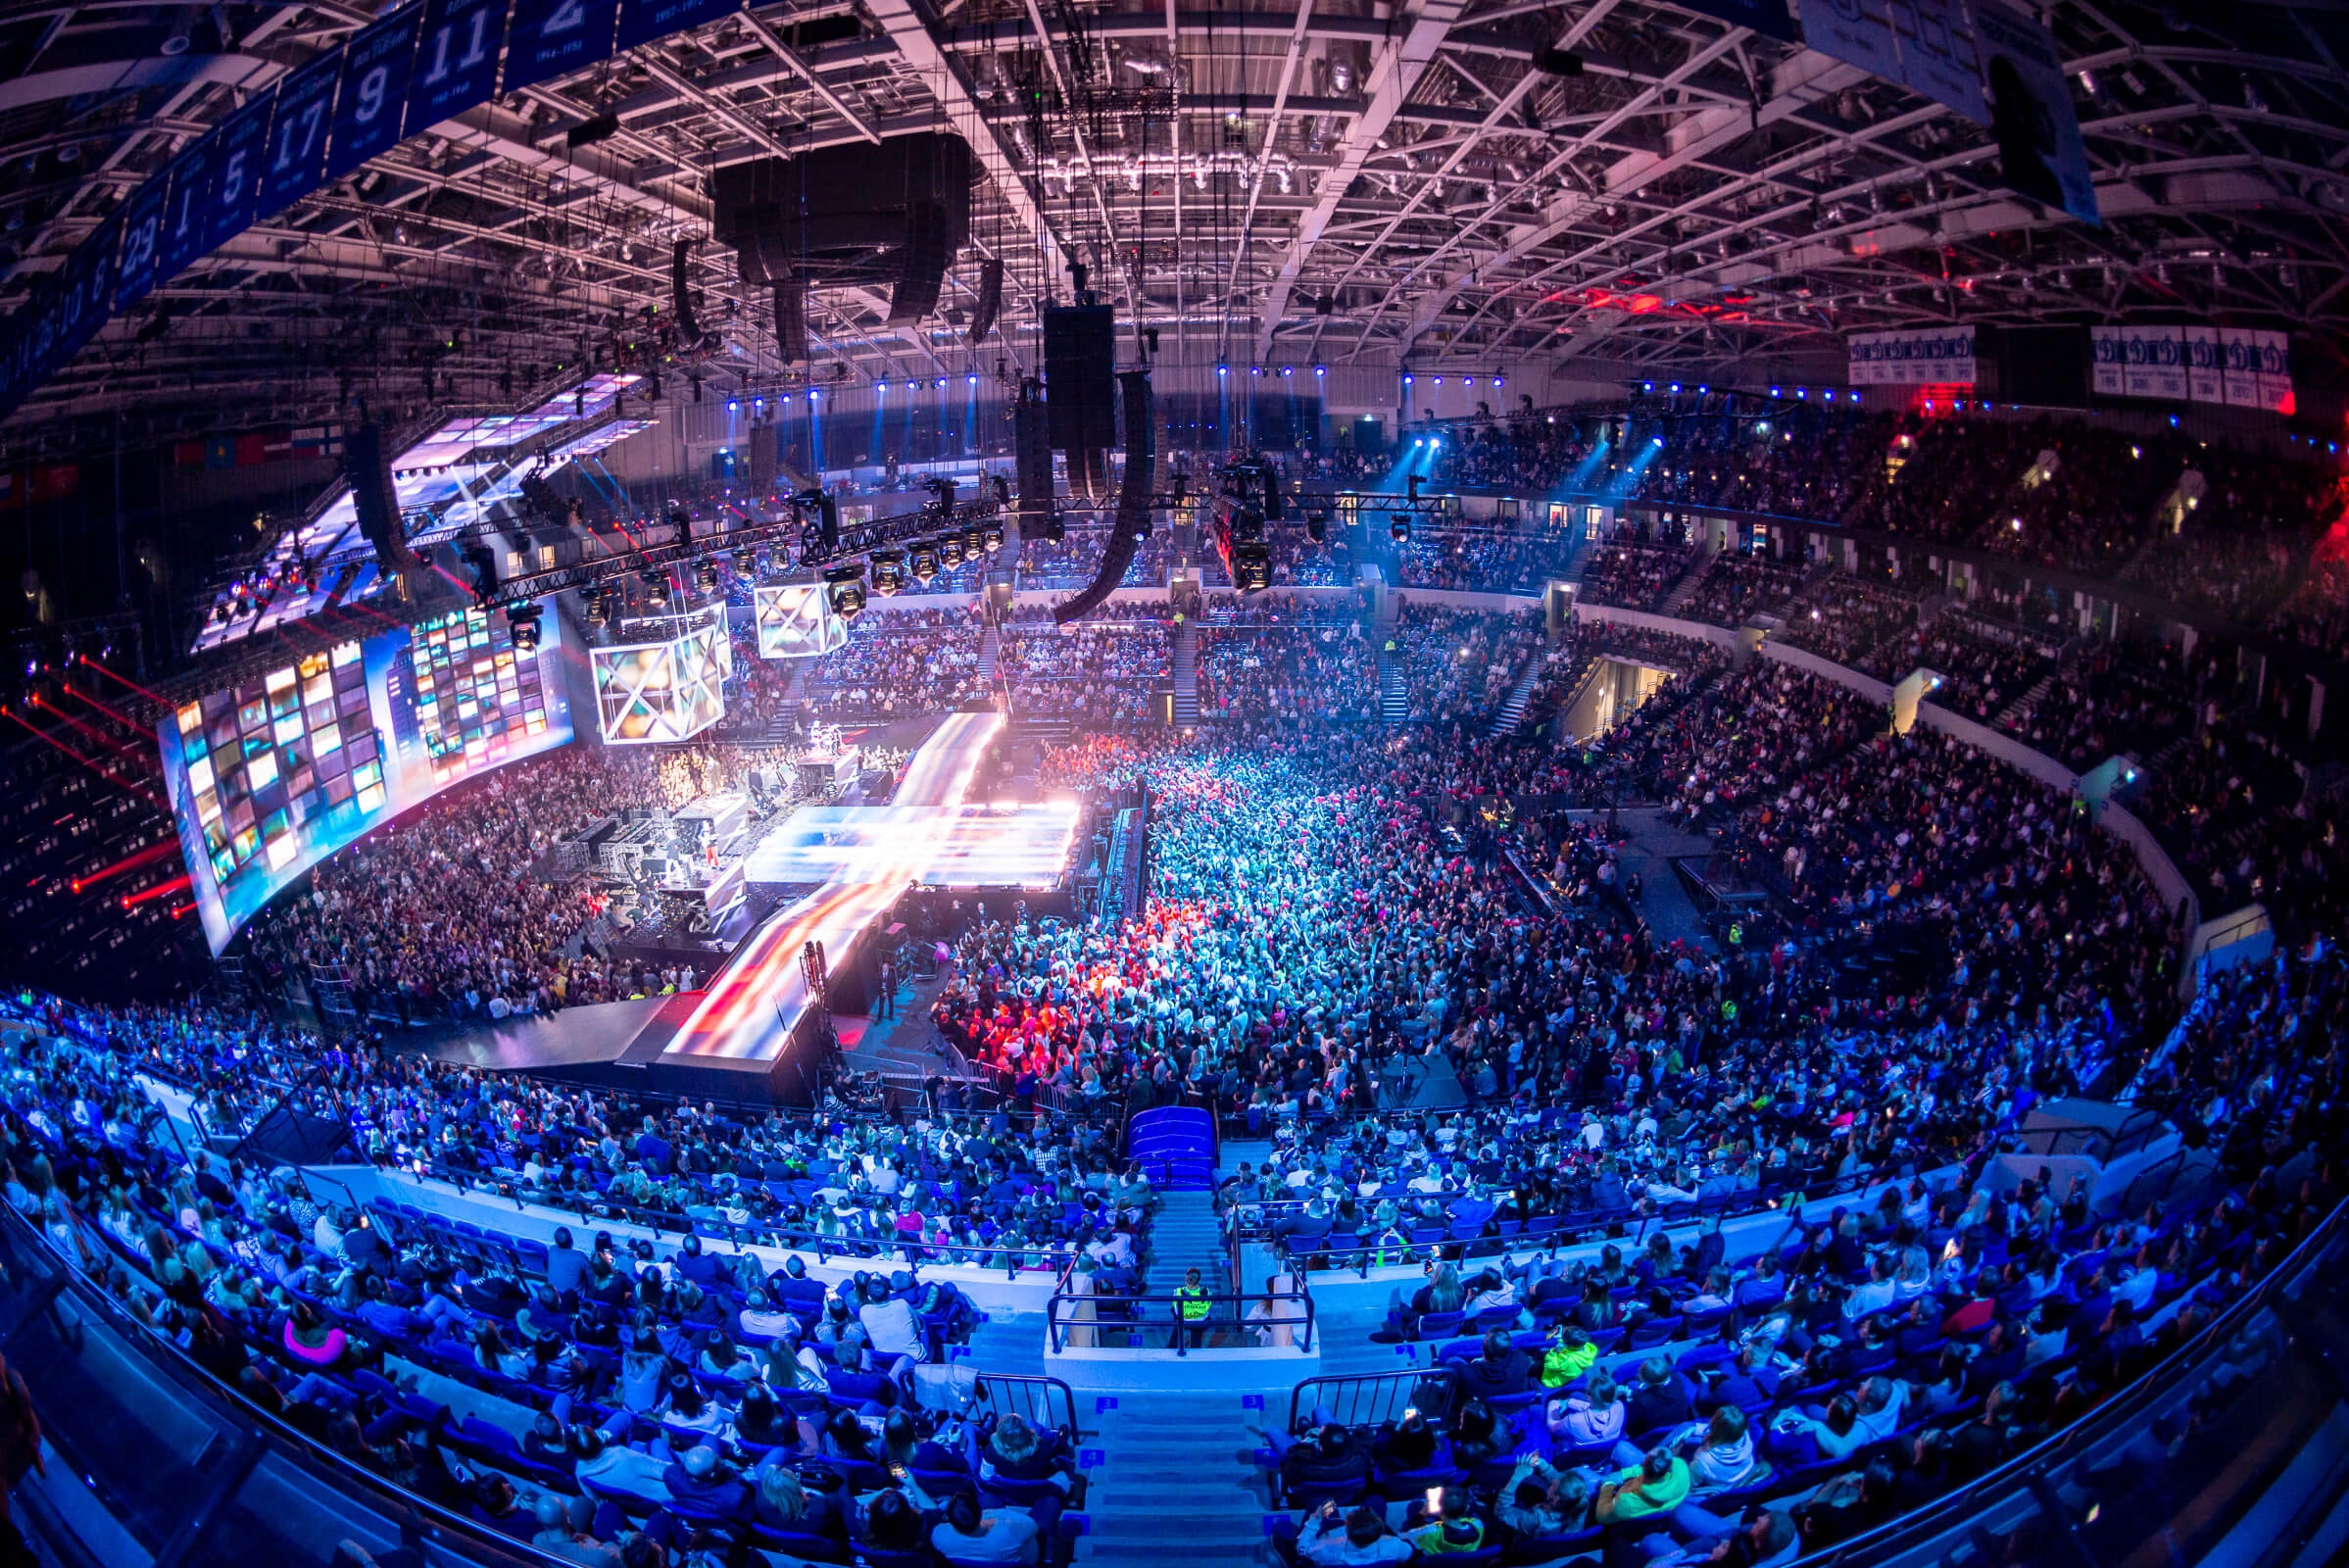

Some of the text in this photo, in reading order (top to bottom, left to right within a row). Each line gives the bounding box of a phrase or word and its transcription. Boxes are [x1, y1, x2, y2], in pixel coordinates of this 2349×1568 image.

[423, 7, 488, 88] 11
[354, 65, 390, 124] 9
[271, 96, 327, 175] 17
[223, 148, 247, 204] 5
[122, 215, 158, 278] 29
[1088, 1451, 1097, 1460] 4
